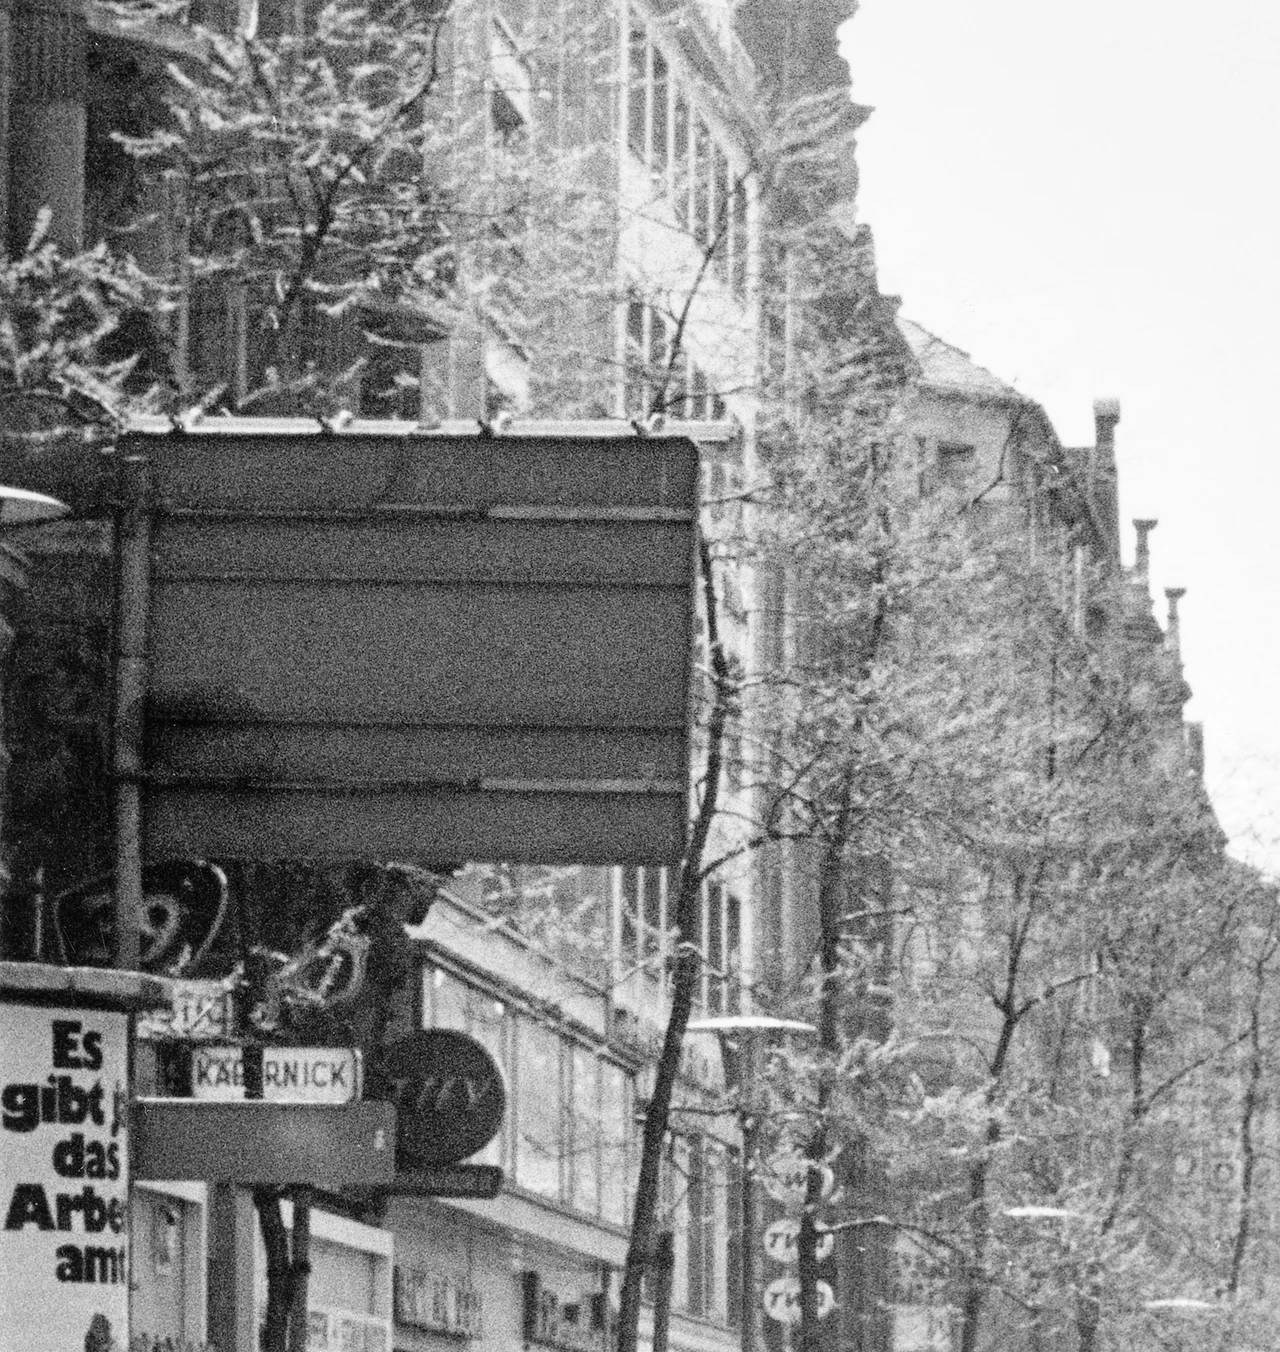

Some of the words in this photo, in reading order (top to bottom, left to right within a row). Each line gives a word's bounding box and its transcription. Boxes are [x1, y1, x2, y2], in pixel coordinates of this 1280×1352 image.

[52, 1019, 103, 1071] Es
[196, 1060, 349, 1088] KABRNICK
[1, 1073, 105, 1133] gibt
[52, 1132, 120, 1180] das
